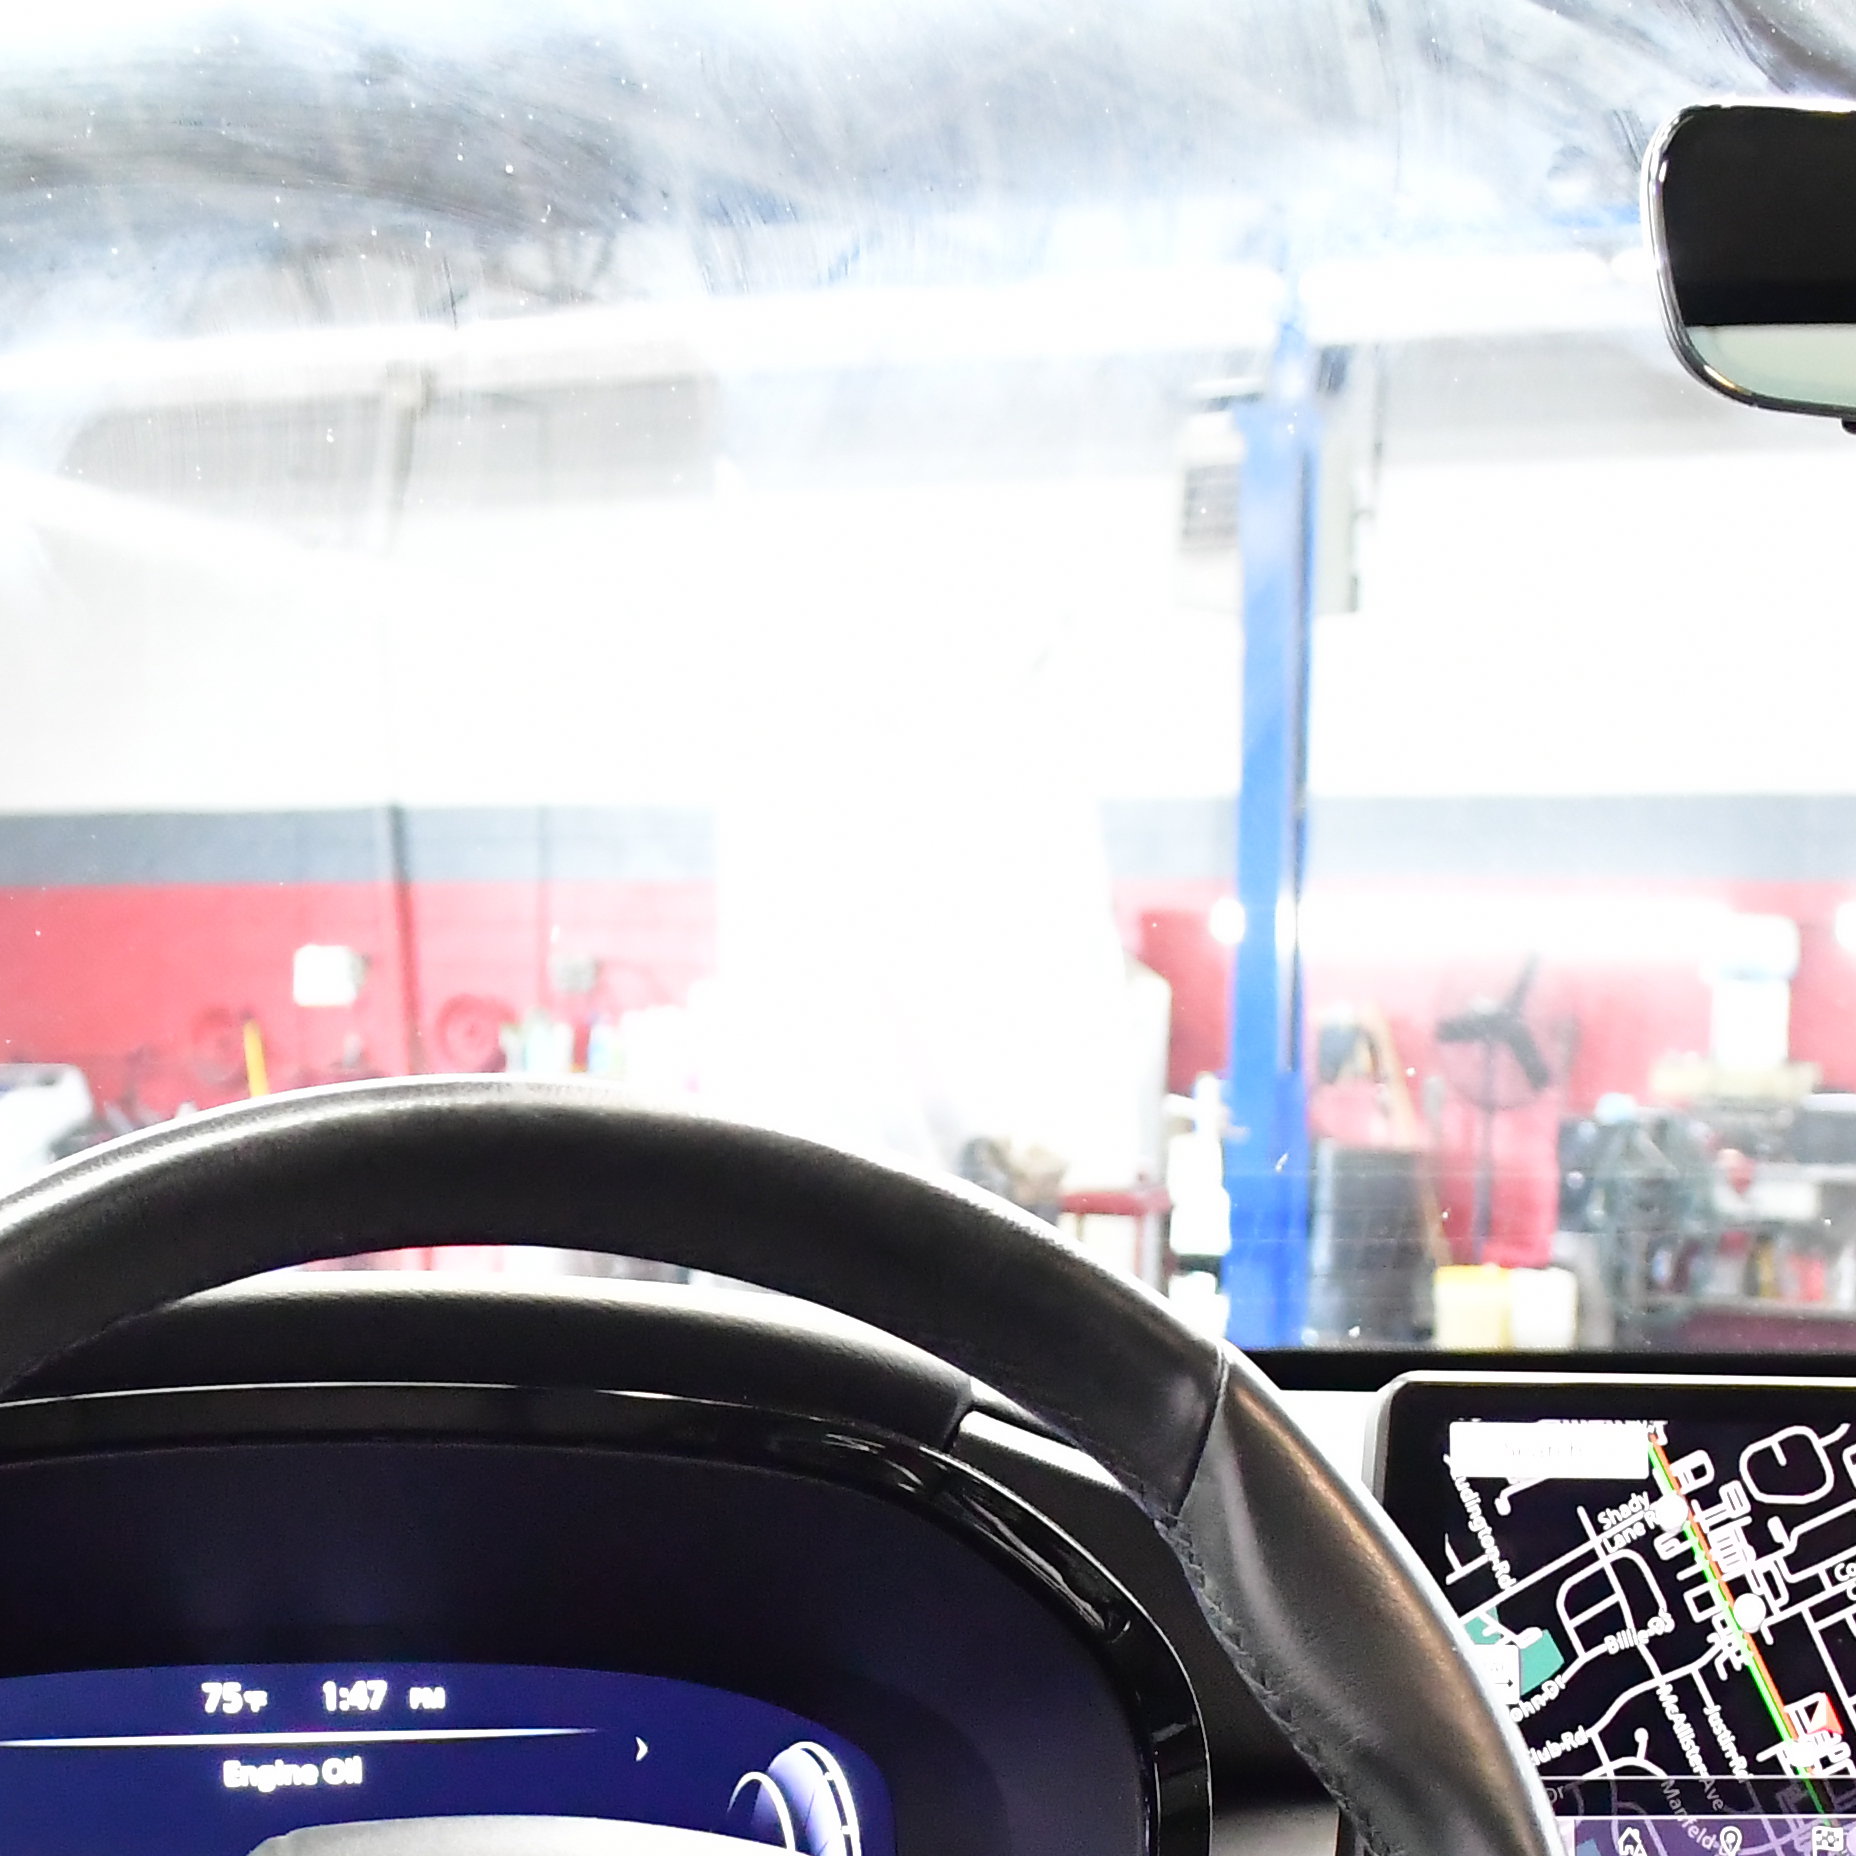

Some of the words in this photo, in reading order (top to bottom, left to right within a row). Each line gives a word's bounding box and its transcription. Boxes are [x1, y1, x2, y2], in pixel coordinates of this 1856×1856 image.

[1454, 1475, 1499, 1560] udington
[1597, 1492, 1652, 1530] Shady
[1602, 1519, 1645, 1553] Lane
[322, 1679, 388, 1711] 1:47
[408, 1686, 446, 1709] PM
[1510, 1694, 1541, 1723] ohn
[223, 1759, 319, 1792] Engine
[321, 1755, 363, 1785] Oil
